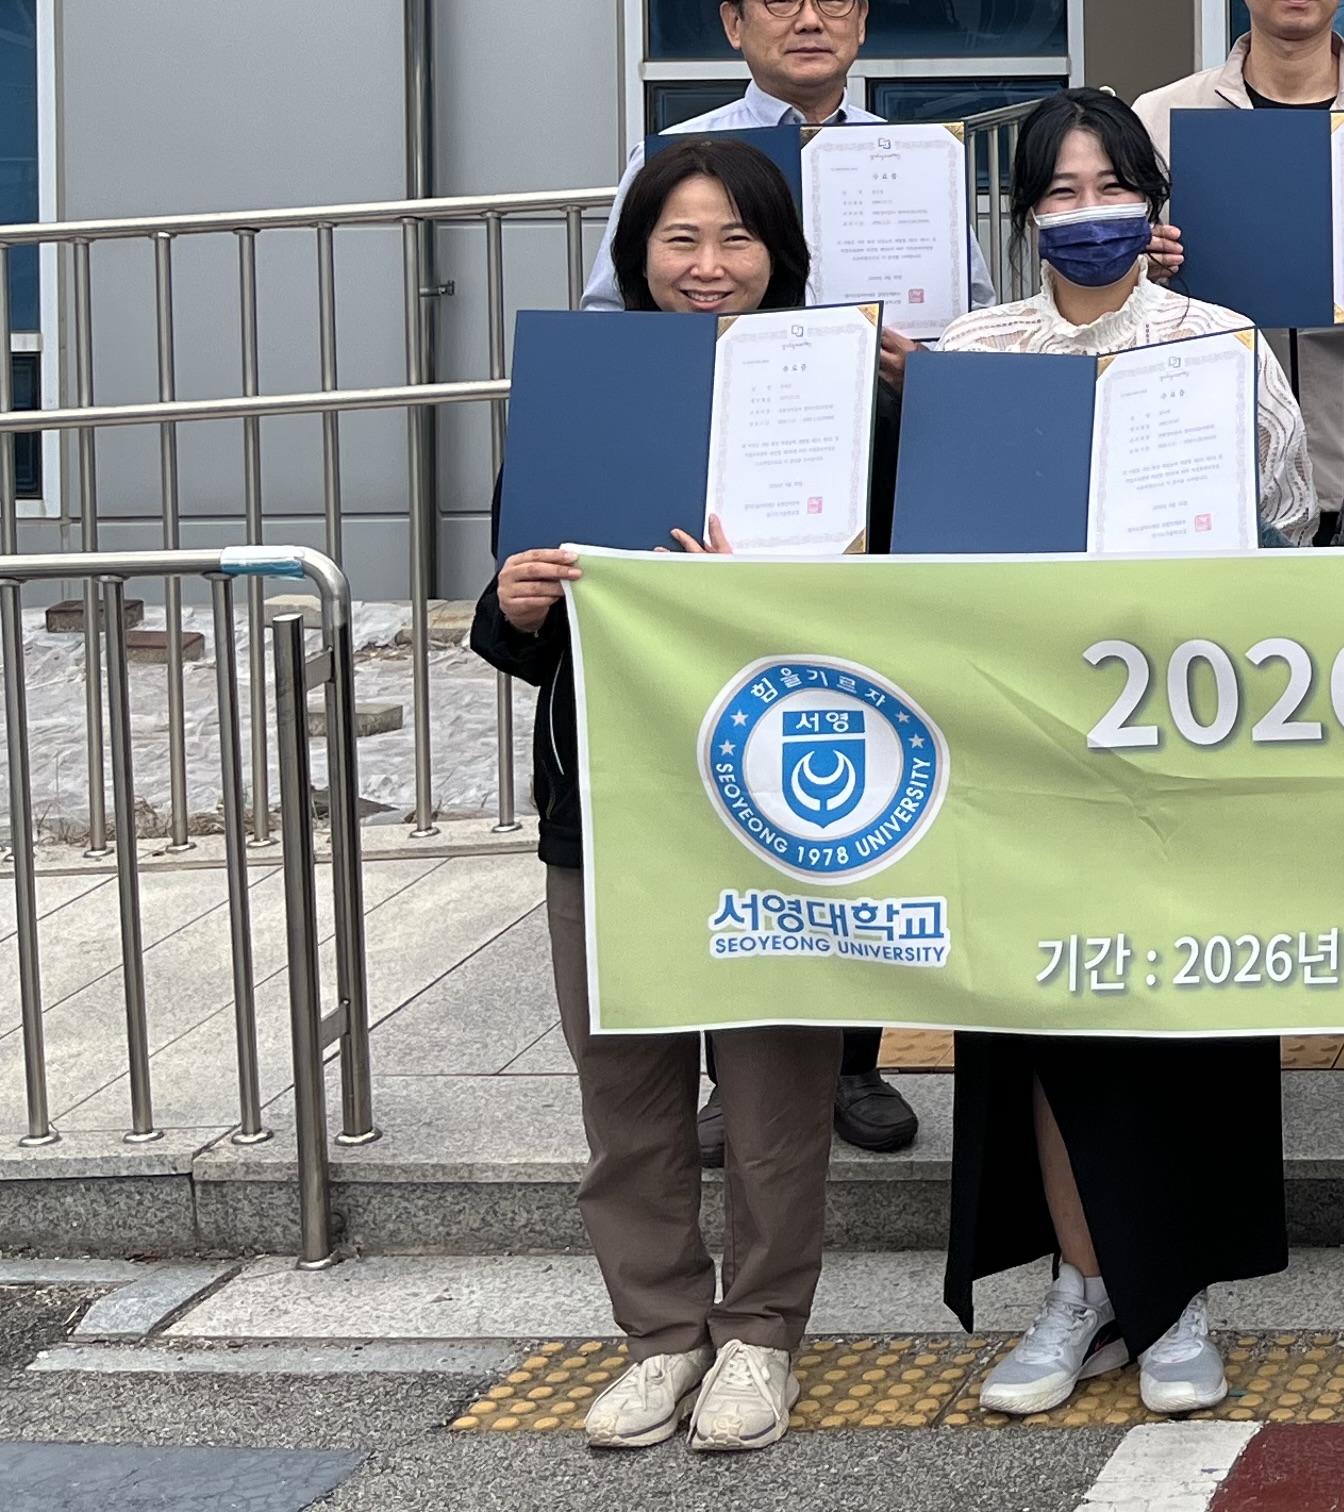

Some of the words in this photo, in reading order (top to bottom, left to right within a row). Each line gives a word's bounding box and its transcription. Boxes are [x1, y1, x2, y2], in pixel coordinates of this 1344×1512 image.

[795, 711, 849, 733] 서영
[715, 762, 788, 854] SEOYEONG
[796, 845, 849, 867] 1978
[855, 756, 932, 857] UNIVERSITY
[713, 893, 945, 942] 서영대학교
[714, 934, 831, 955] SEOYEONG
[838, 941, 946, 963] UNIVERSITY
[1035, 933, 1131, 991] 기간
[1172, 927, 1340, 986] 2026년
